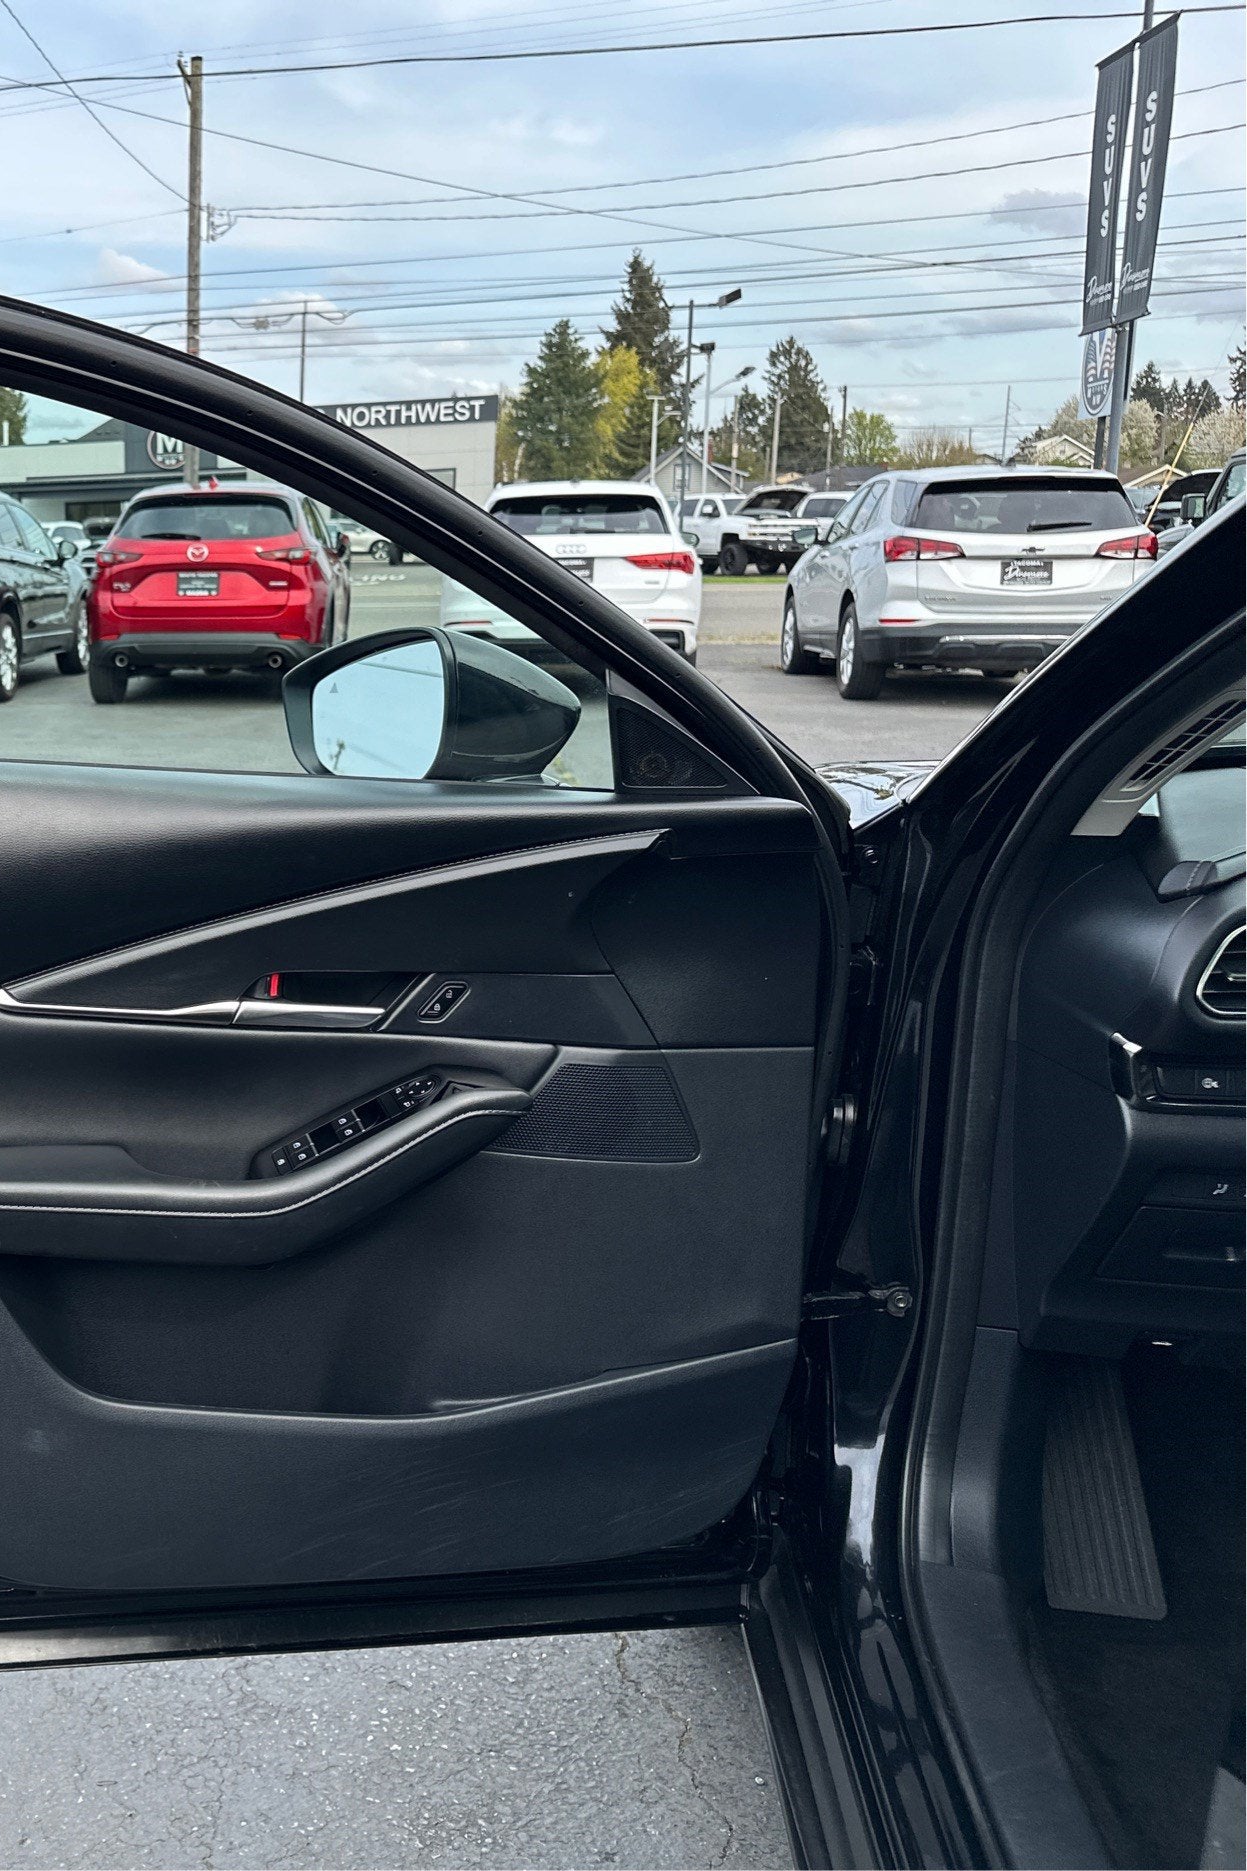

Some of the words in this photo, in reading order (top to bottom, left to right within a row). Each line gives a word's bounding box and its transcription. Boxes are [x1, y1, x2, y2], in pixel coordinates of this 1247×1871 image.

[1100, 114, 1117, 238] SUVS
[1135, 90, 1158, 222] SUVS
[156, 432, 183, 454] M
[336, 399, 486, 427] NORTHWEST
